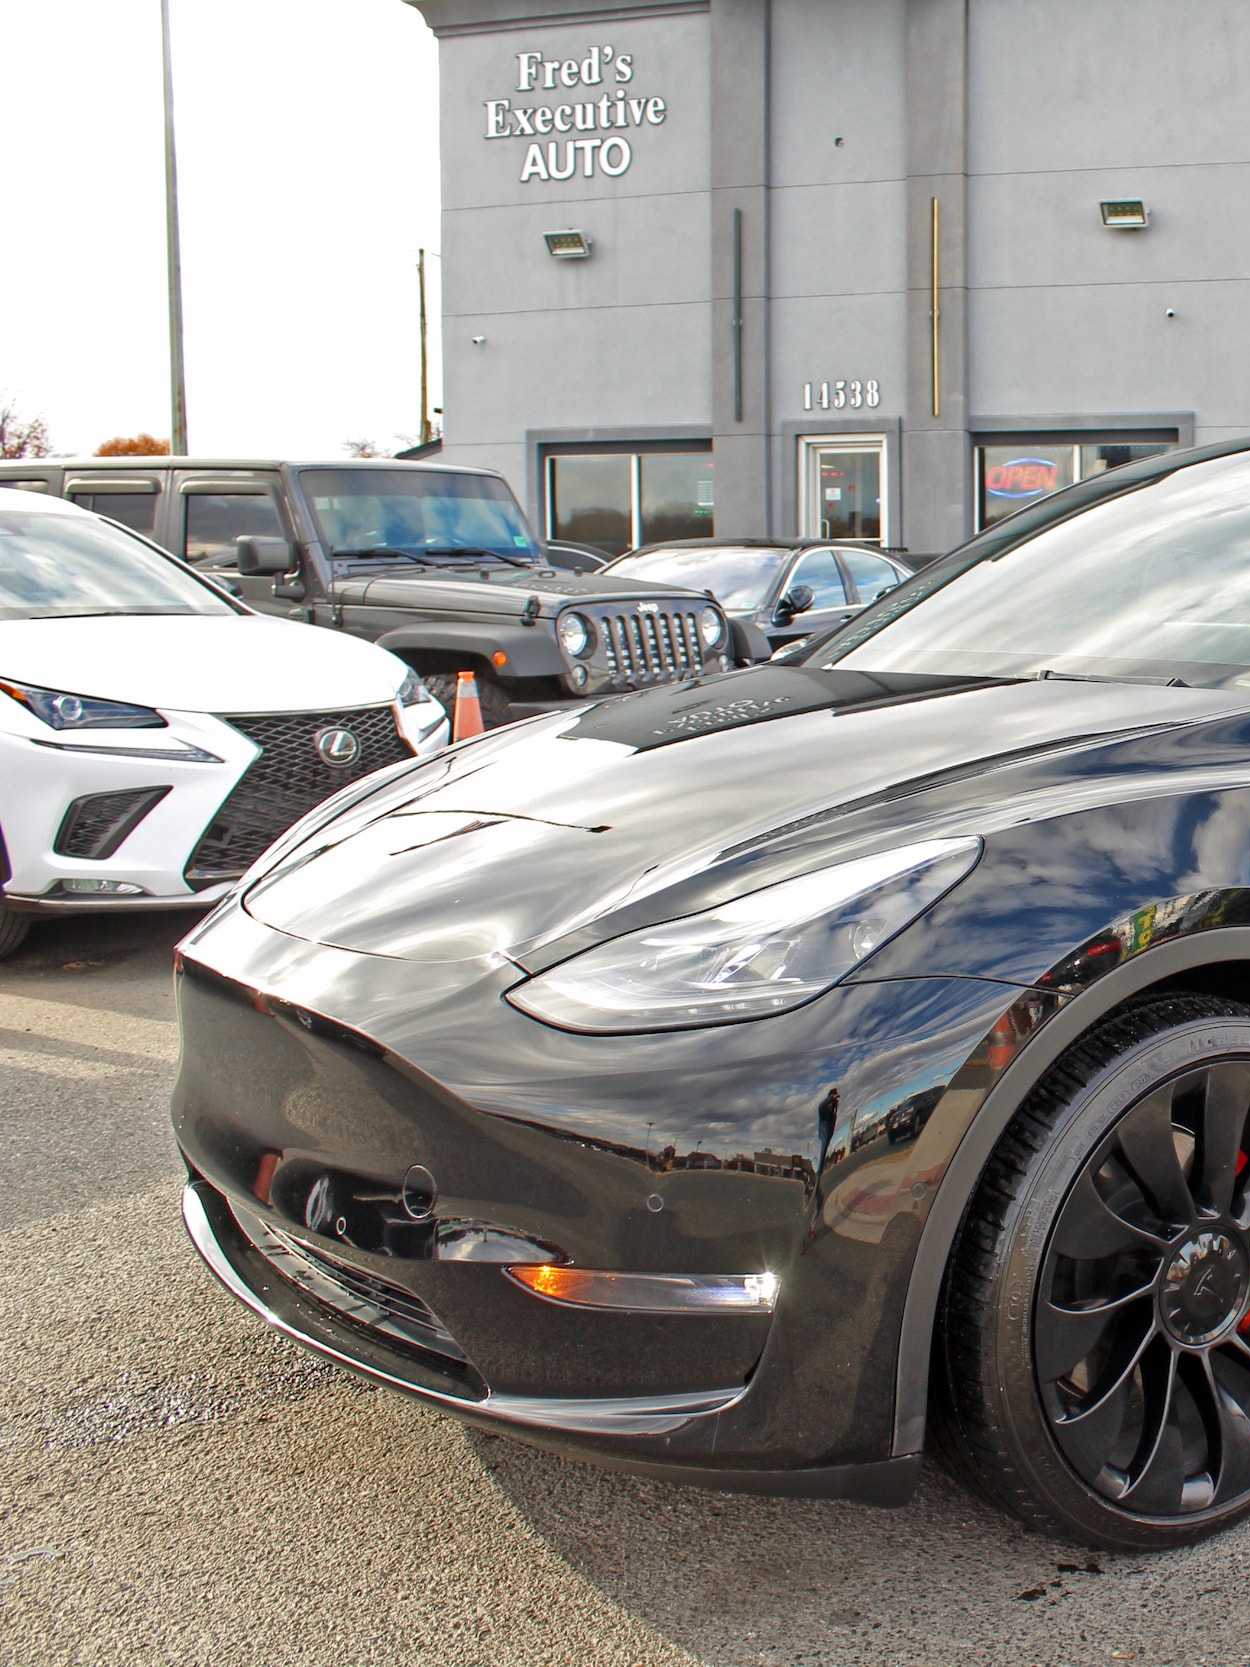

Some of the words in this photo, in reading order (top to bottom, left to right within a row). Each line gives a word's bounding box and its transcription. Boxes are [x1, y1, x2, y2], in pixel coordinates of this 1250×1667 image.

[484, 88, 667, 139] Executive
[519, 136, 632, 182] AUTO
[803, 379, 880, 411] 14538
[985, 464, 1059, 491] OPEN
[636, 601, 659, 613] Jeep
